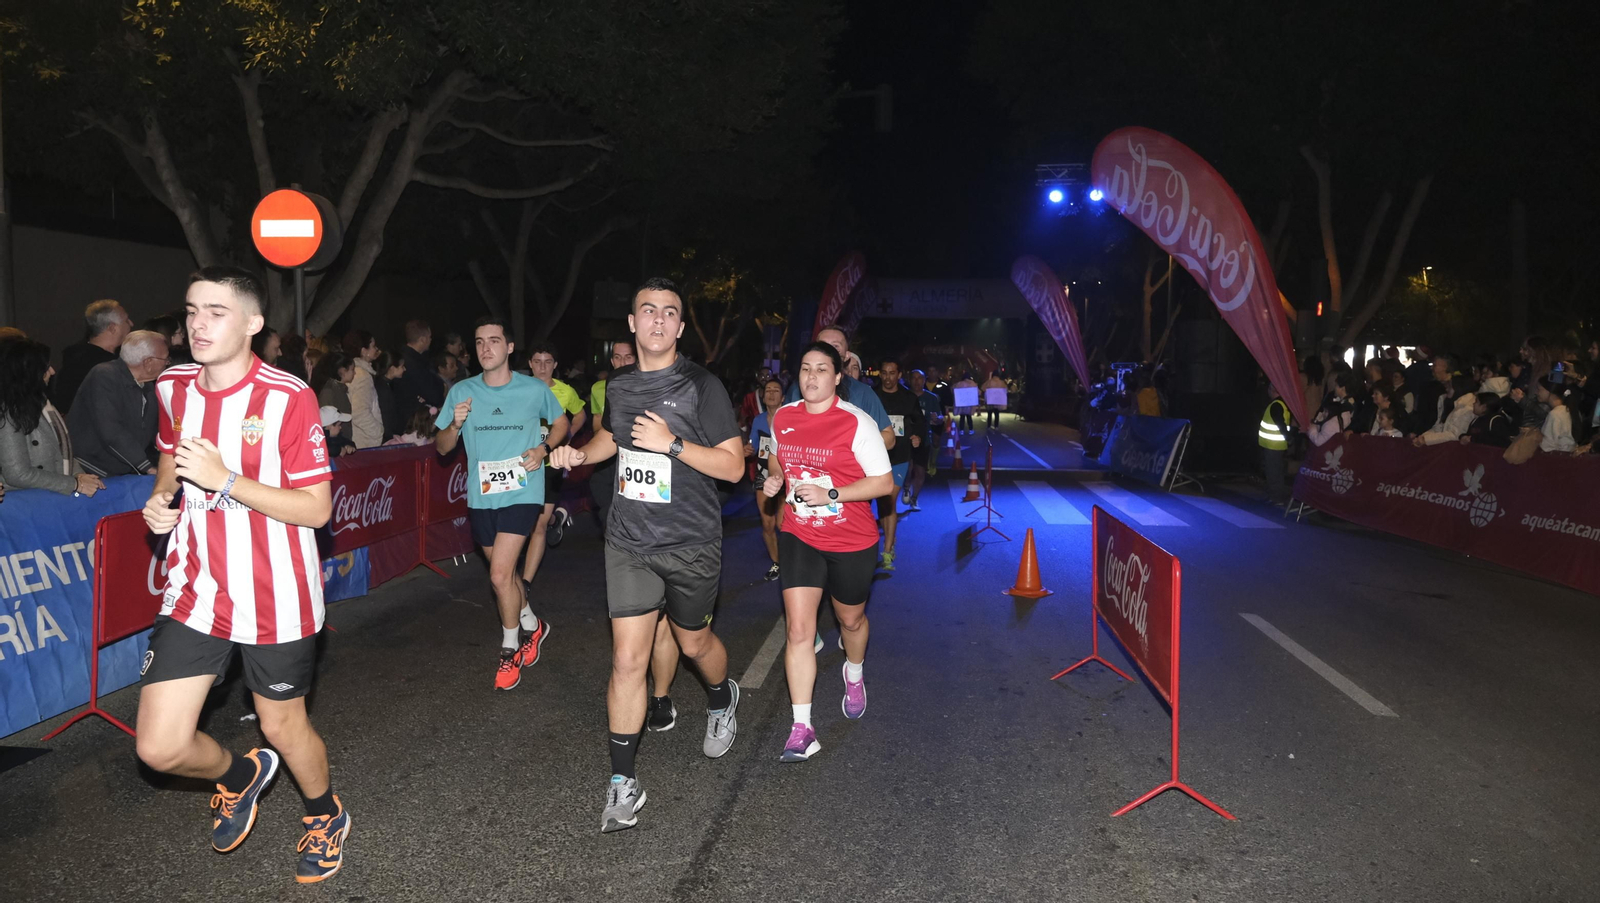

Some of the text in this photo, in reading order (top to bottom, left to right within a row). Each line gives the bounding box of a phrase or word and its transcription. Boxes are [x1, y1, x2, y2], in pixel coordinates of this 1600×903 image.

[1121, 446, 1165, 475] deporte
[489, 470, 515, 482] 291
[625, 466, 656, 485] 908
[1376, 481, 1472, 512] aquéatacamos
